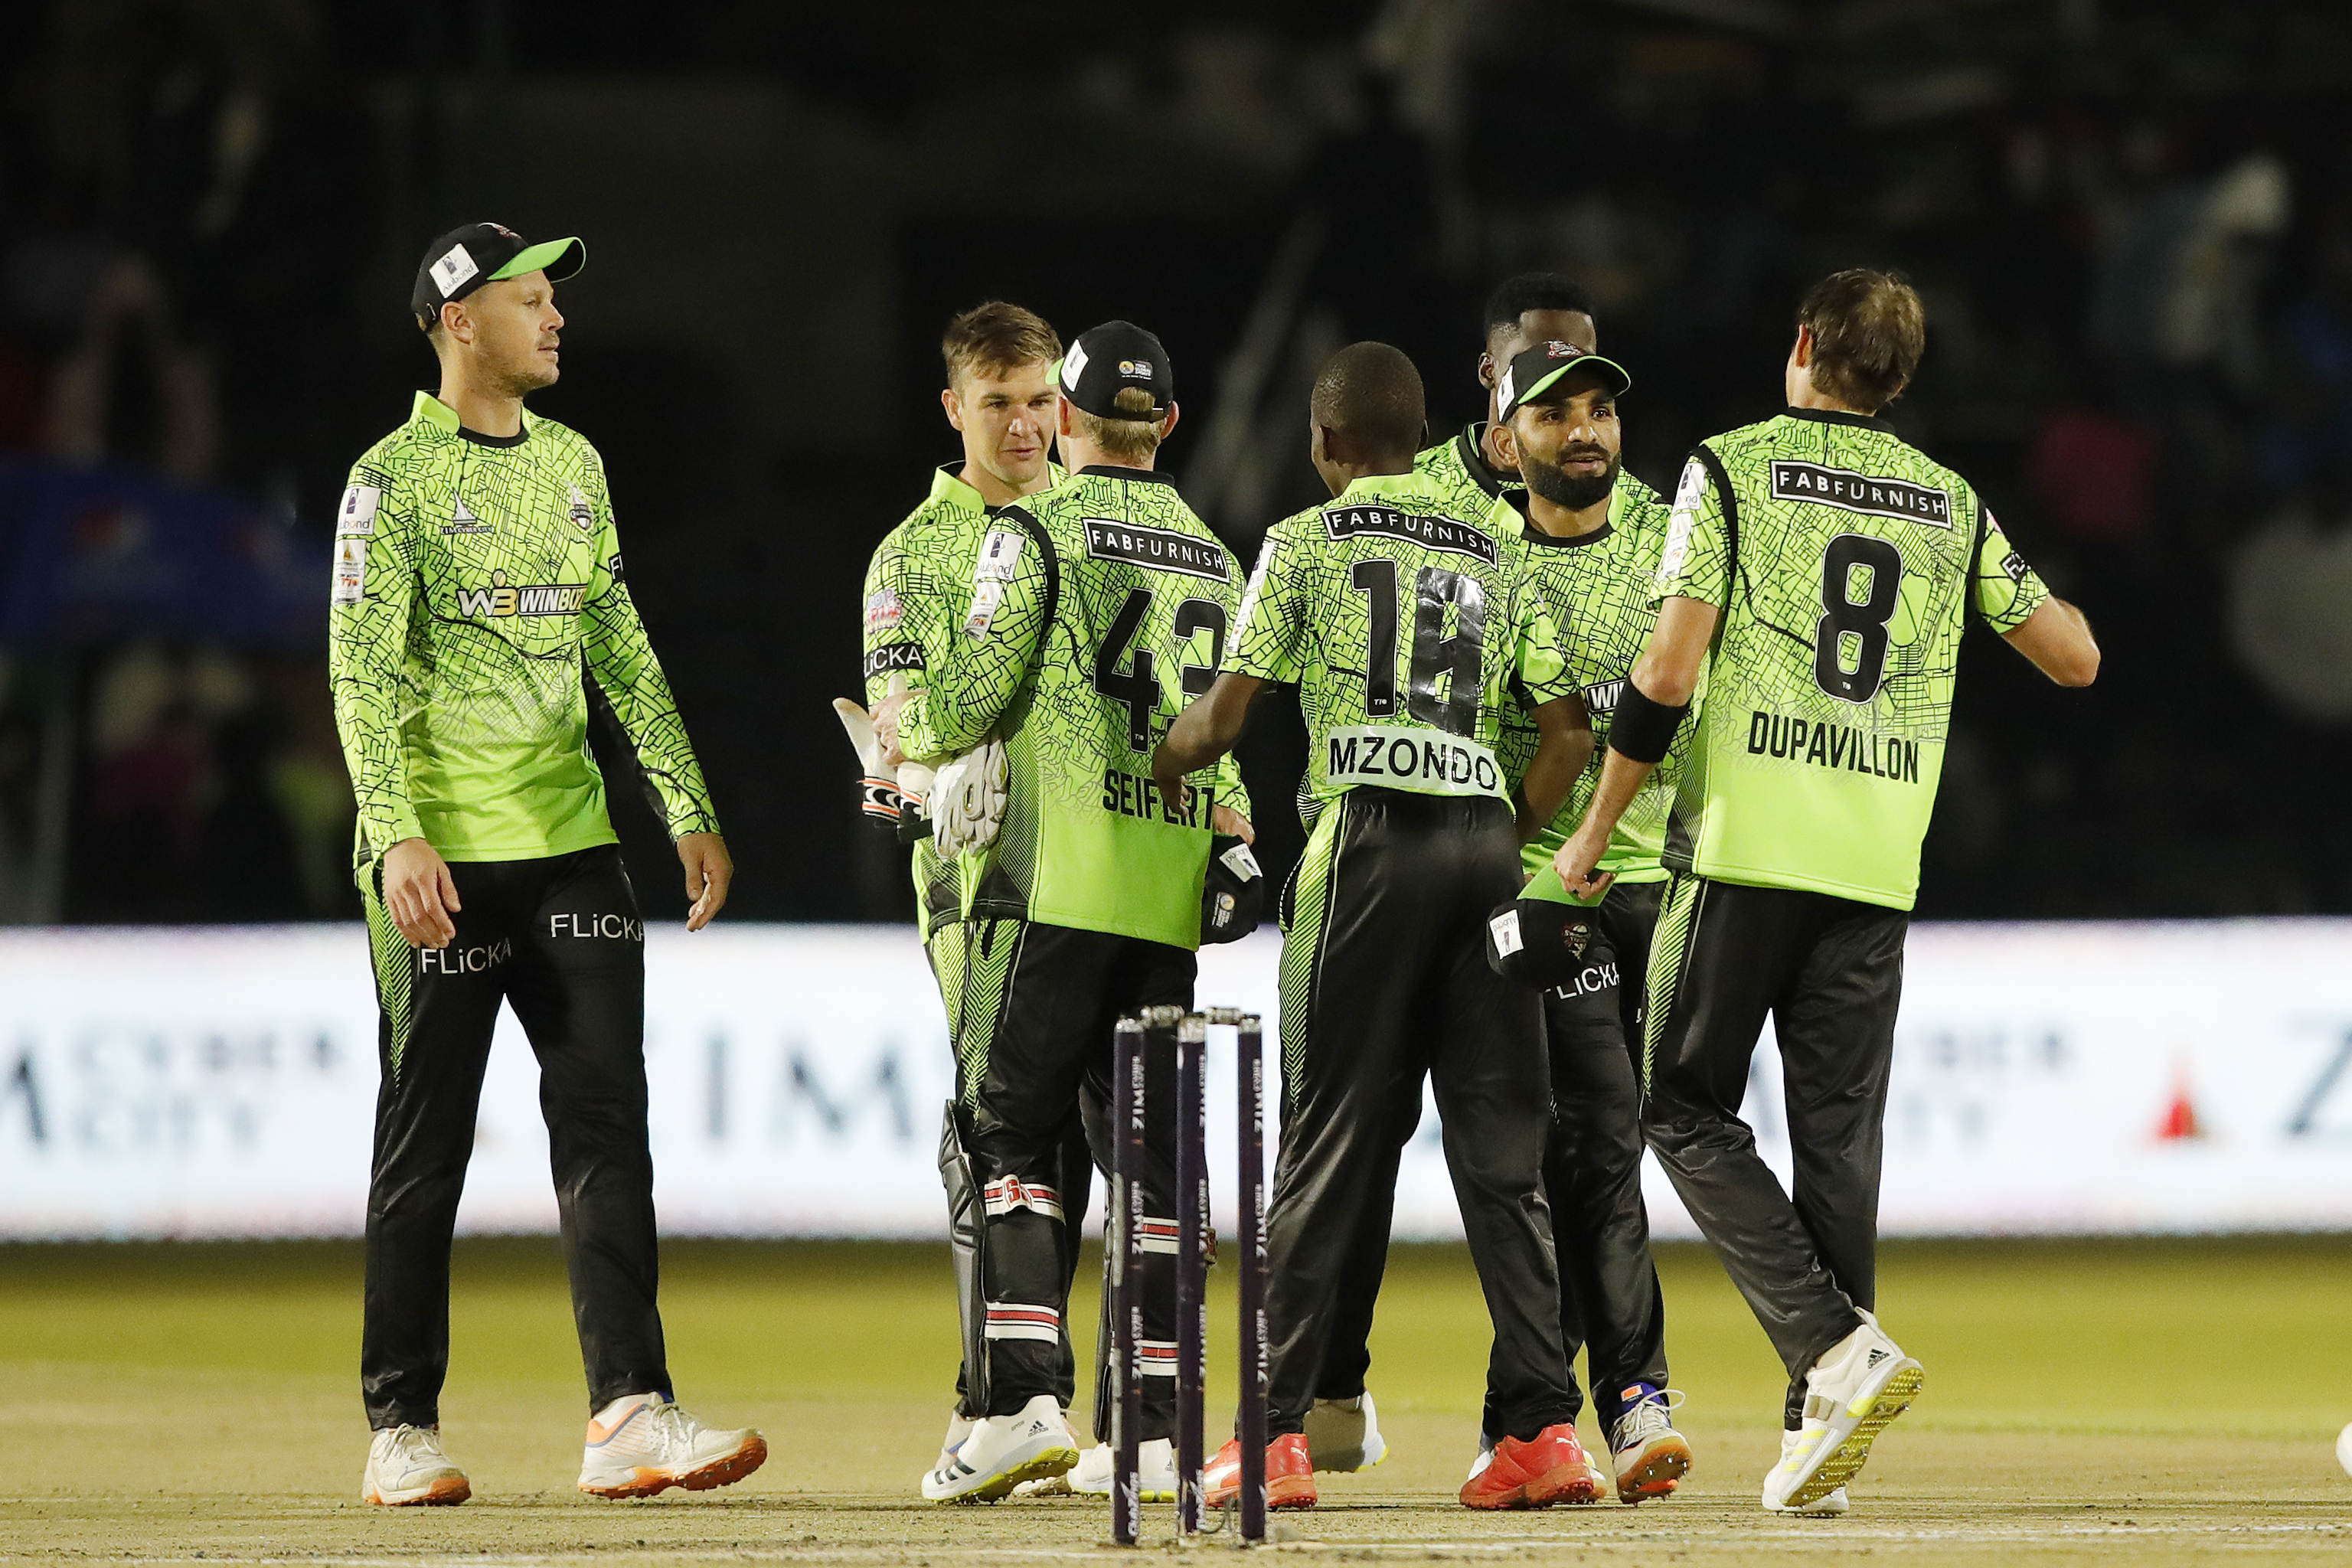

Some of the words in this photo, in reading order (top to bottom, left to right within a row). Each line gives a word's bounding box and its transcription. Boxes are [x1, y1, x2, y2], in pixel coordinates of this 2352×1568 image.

[443, 261, 474, 292] Alubond
[1779, 470, 1946, 516] FABFURNISH
[1092, 529, 1225, 570] FABFURNISH
[1332, 511, 1493, 556] FABFURNISH
[457, 588, 518, 617] W3
[1814, 533, 1904, 705] 8
[864, 645, 924, 678] LiCKA
[1093, 586, 1228, 753] 43
[1351, 557, 1486, 740] 18
[1328, 736, 1498, 792] MZONDO
[1747, 710, 1919, 785] DUPAVILLON
[421, 937, 511, 975] FLiCKA
[701, 1026, 917, 1145] IM
[1027, 1426, 1049, 1438] adidas
